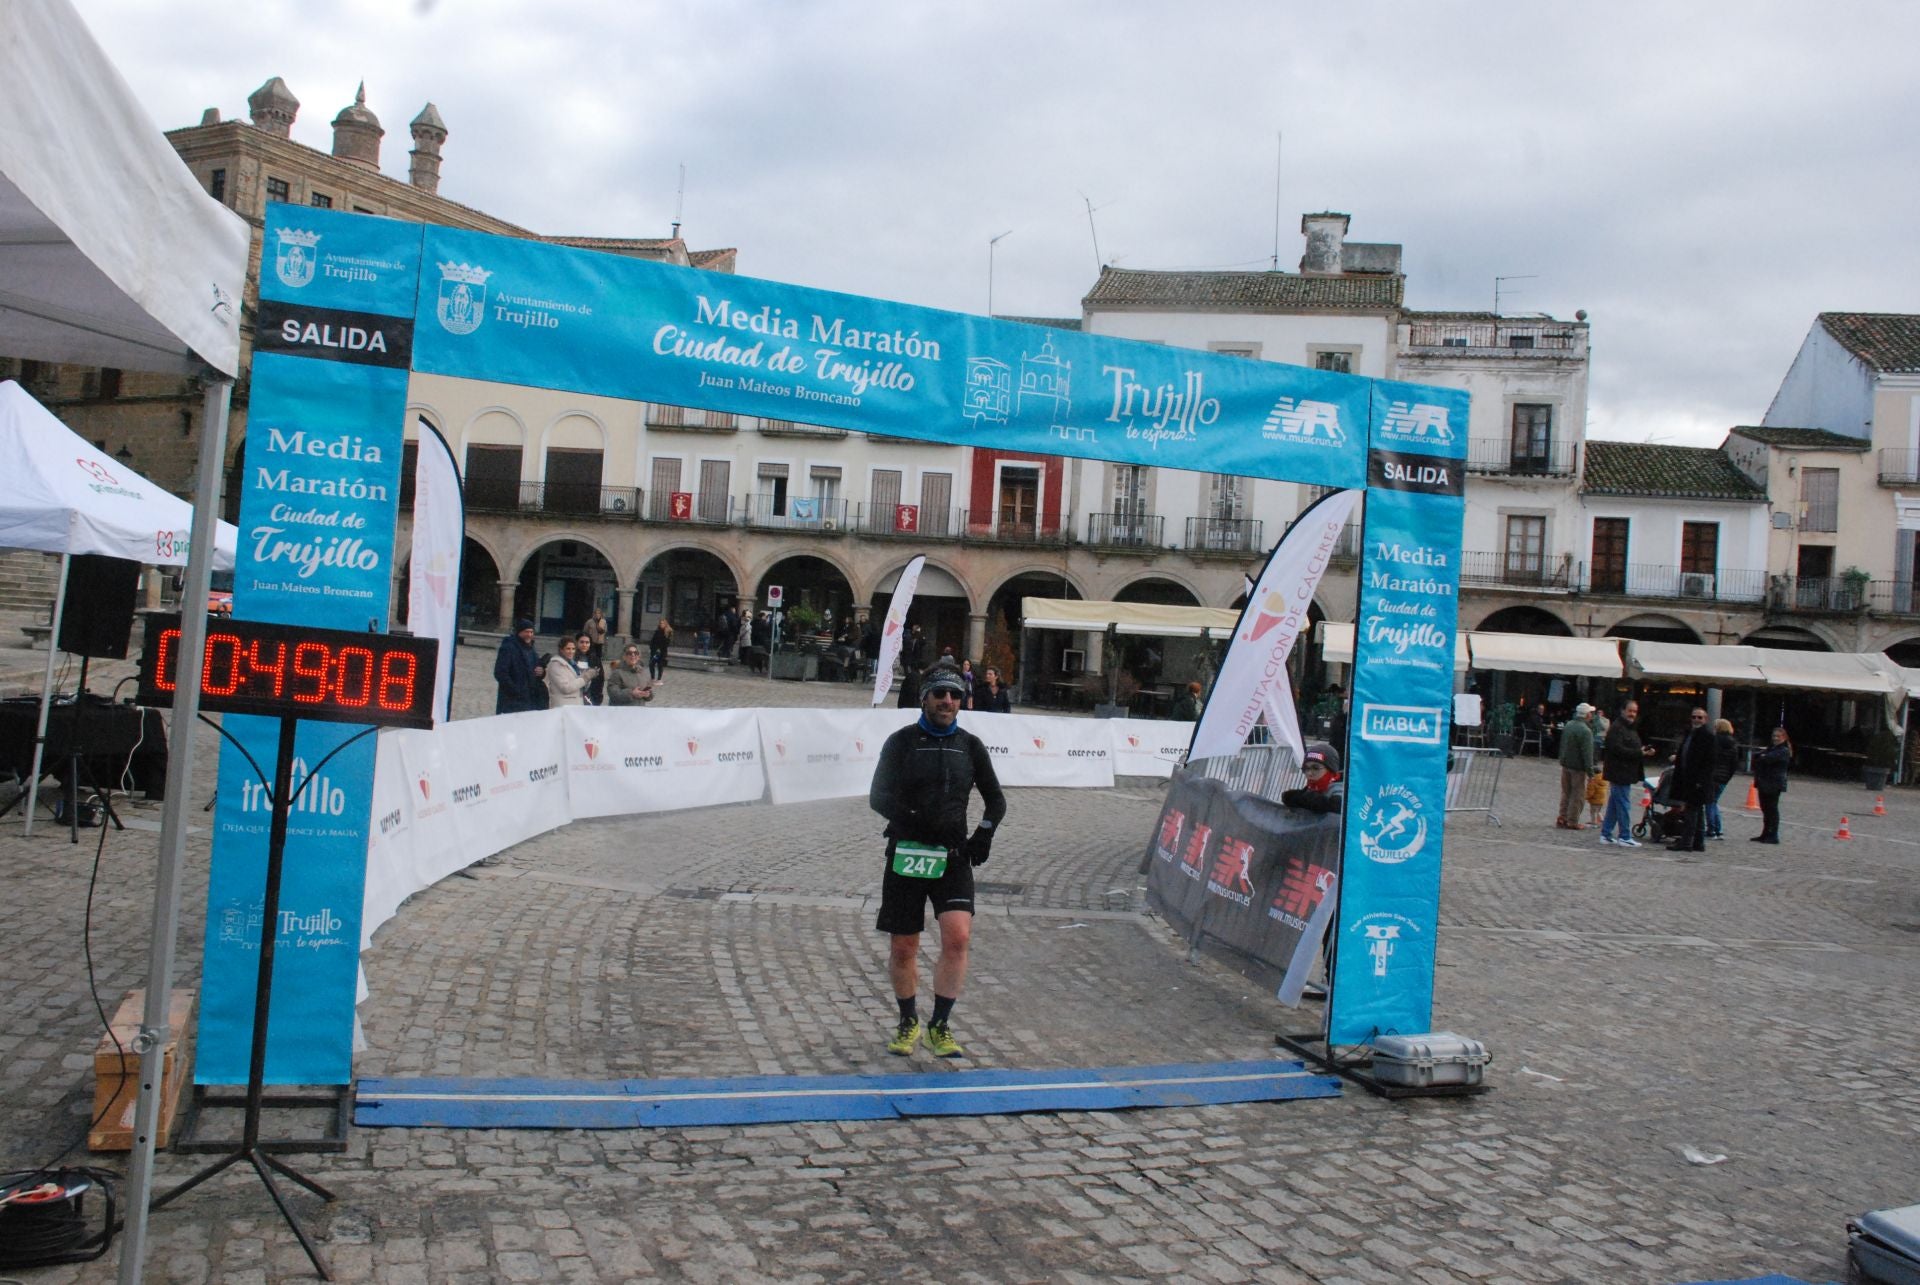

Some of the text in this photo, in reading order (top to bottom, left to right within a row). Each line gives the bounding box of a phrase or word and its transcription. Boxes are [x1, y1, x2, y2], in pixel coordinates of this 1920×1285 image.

[323, 264, 377, 282] Trujillo
[325, 252, 406, 271] Ayuntamiento de
[495, 291, 592, 316] Ayuntamiento de
[494, 305, 559, 329] Trujillo
[694, 295, 941, 361] Media Maratón
[281, 319, 387, 353] SALIDA
[652, 324, 915, 396] Ciudad de Trujillo
[698, 371, 861, 408] Juan Mateos Broncano
[1102, 364, 1221, 435] Trujillo
[1126, 418, 1140, 440] te
[1262, 431, 1343, 449] www.musicrun.es
[1380, 431, 1450, 447] www.musicrun.es
[266, 428, 382, 463] Media
[255, 467, 387, 502] Maratón
[1384, 461, 1449, 486] SALIDA
[270, 503, 366, 529] Ciudad de
[251, 525, 379, 578] Trujillo
[1376, 543, 1447, 568] Media
[252, 579, 374, 598] Juan Mateos Broncano
[1370, 571, 1451, 596] Maratón
[1285, 604, 1303, 628] DE
[1377, 598, 1437, 617] Ciudad de
[1366, 616, 1446, 654] Trujillo
[155, 629, 417, 712] 00:49:08
[1373, 715, 1429, 733] HABLA
[1378, 783, 1423, 809] Atletismo
[1364, 844, 1411, 859] TRUJILLO
[902, 856, 937, 875] 247
[278, 908, 342, 935] Trujillo
[1369, 942, 1377, 956] A
[1377, 956, 1384, 968] S
